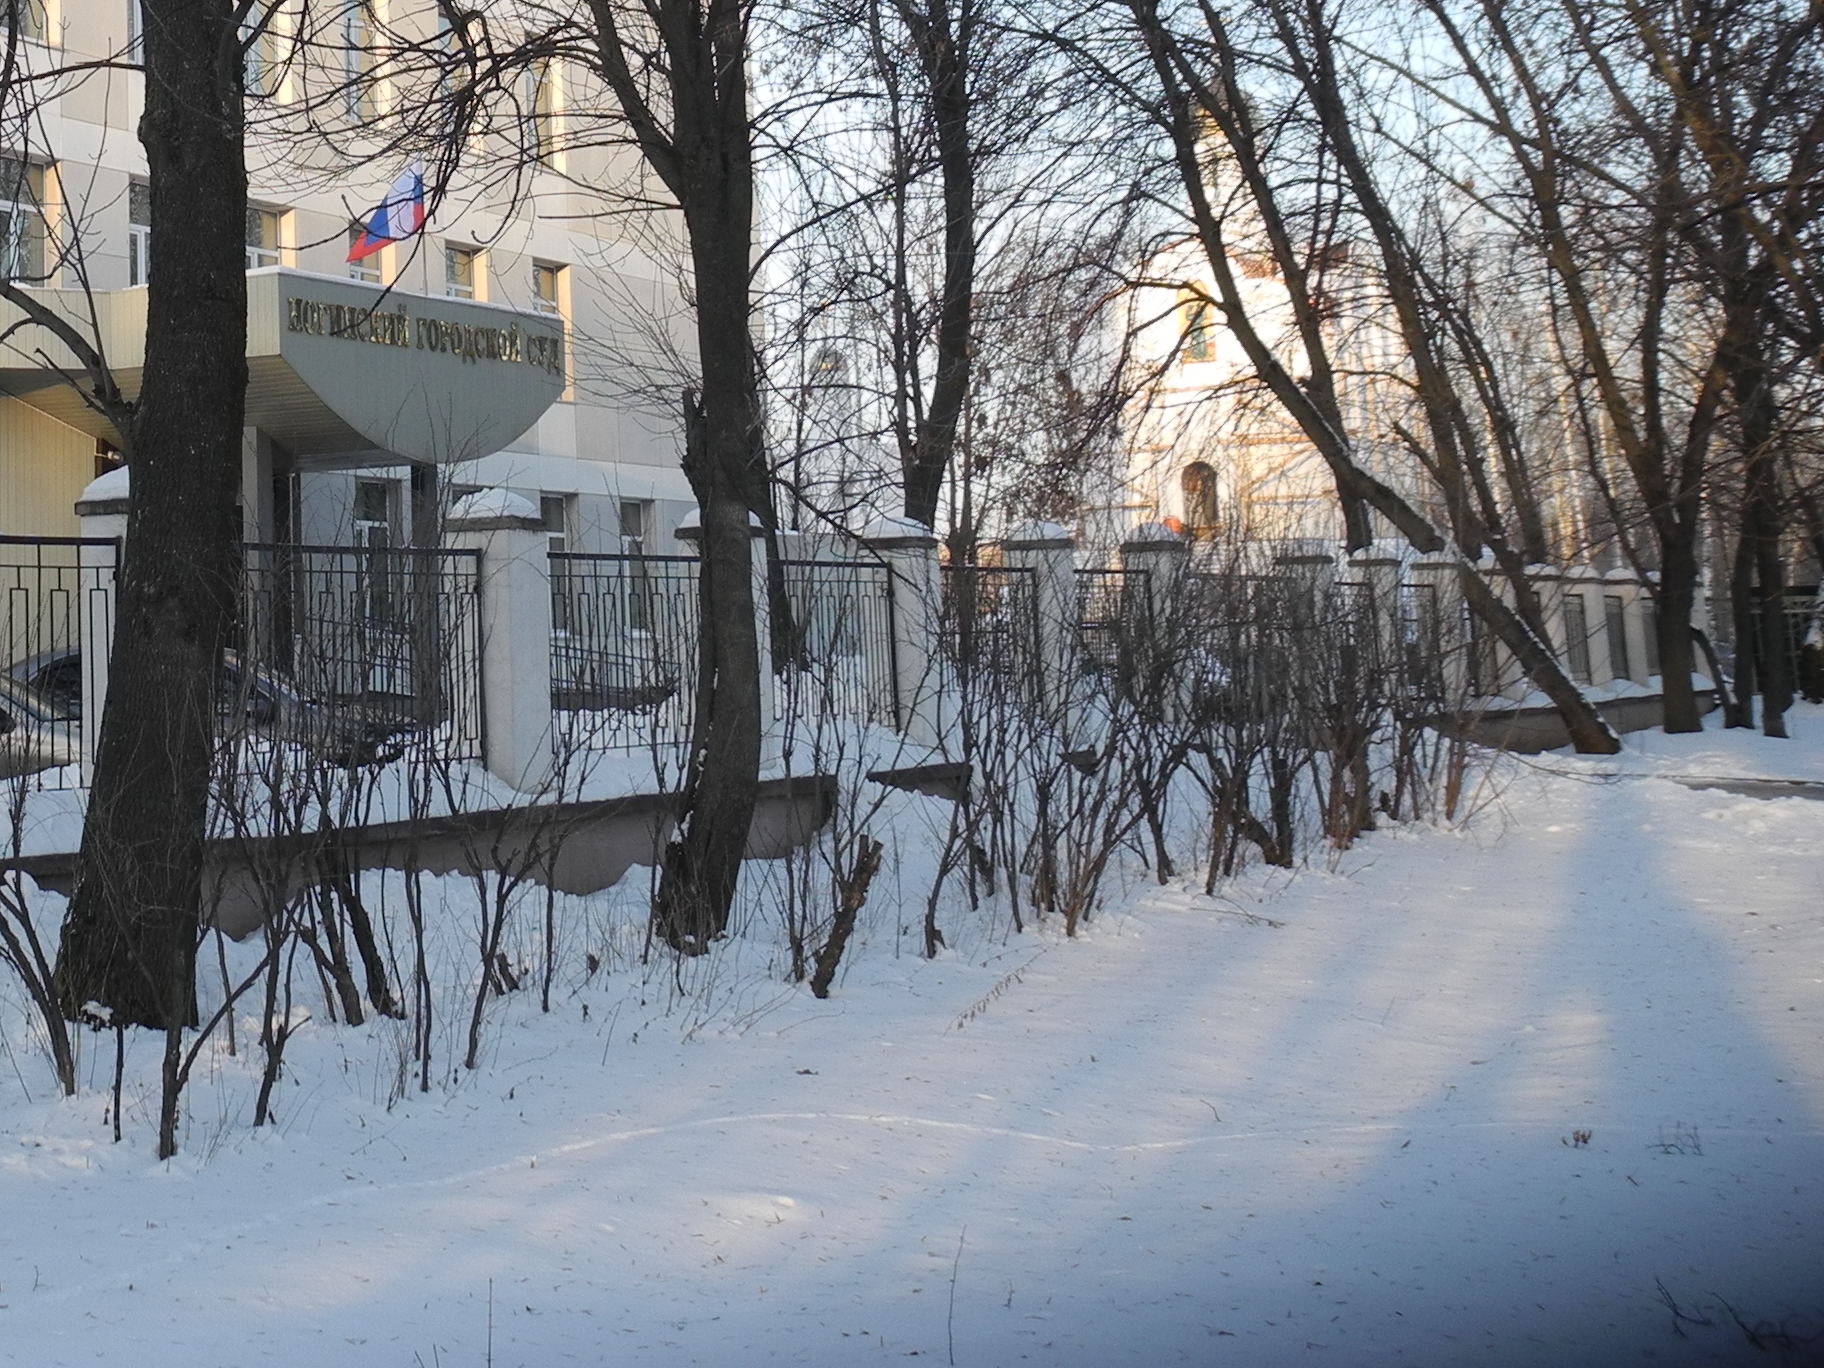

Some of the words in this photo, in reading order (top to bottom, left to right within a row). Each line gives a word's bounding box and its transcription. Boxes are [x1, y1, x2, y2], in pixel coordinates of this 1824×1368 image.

[287, 297, 410, 347] НОГИНСКИЙ
[416, 317, 522, 364] ГОРОДСКОЙ
[527, 335, 562, 375] СУД
